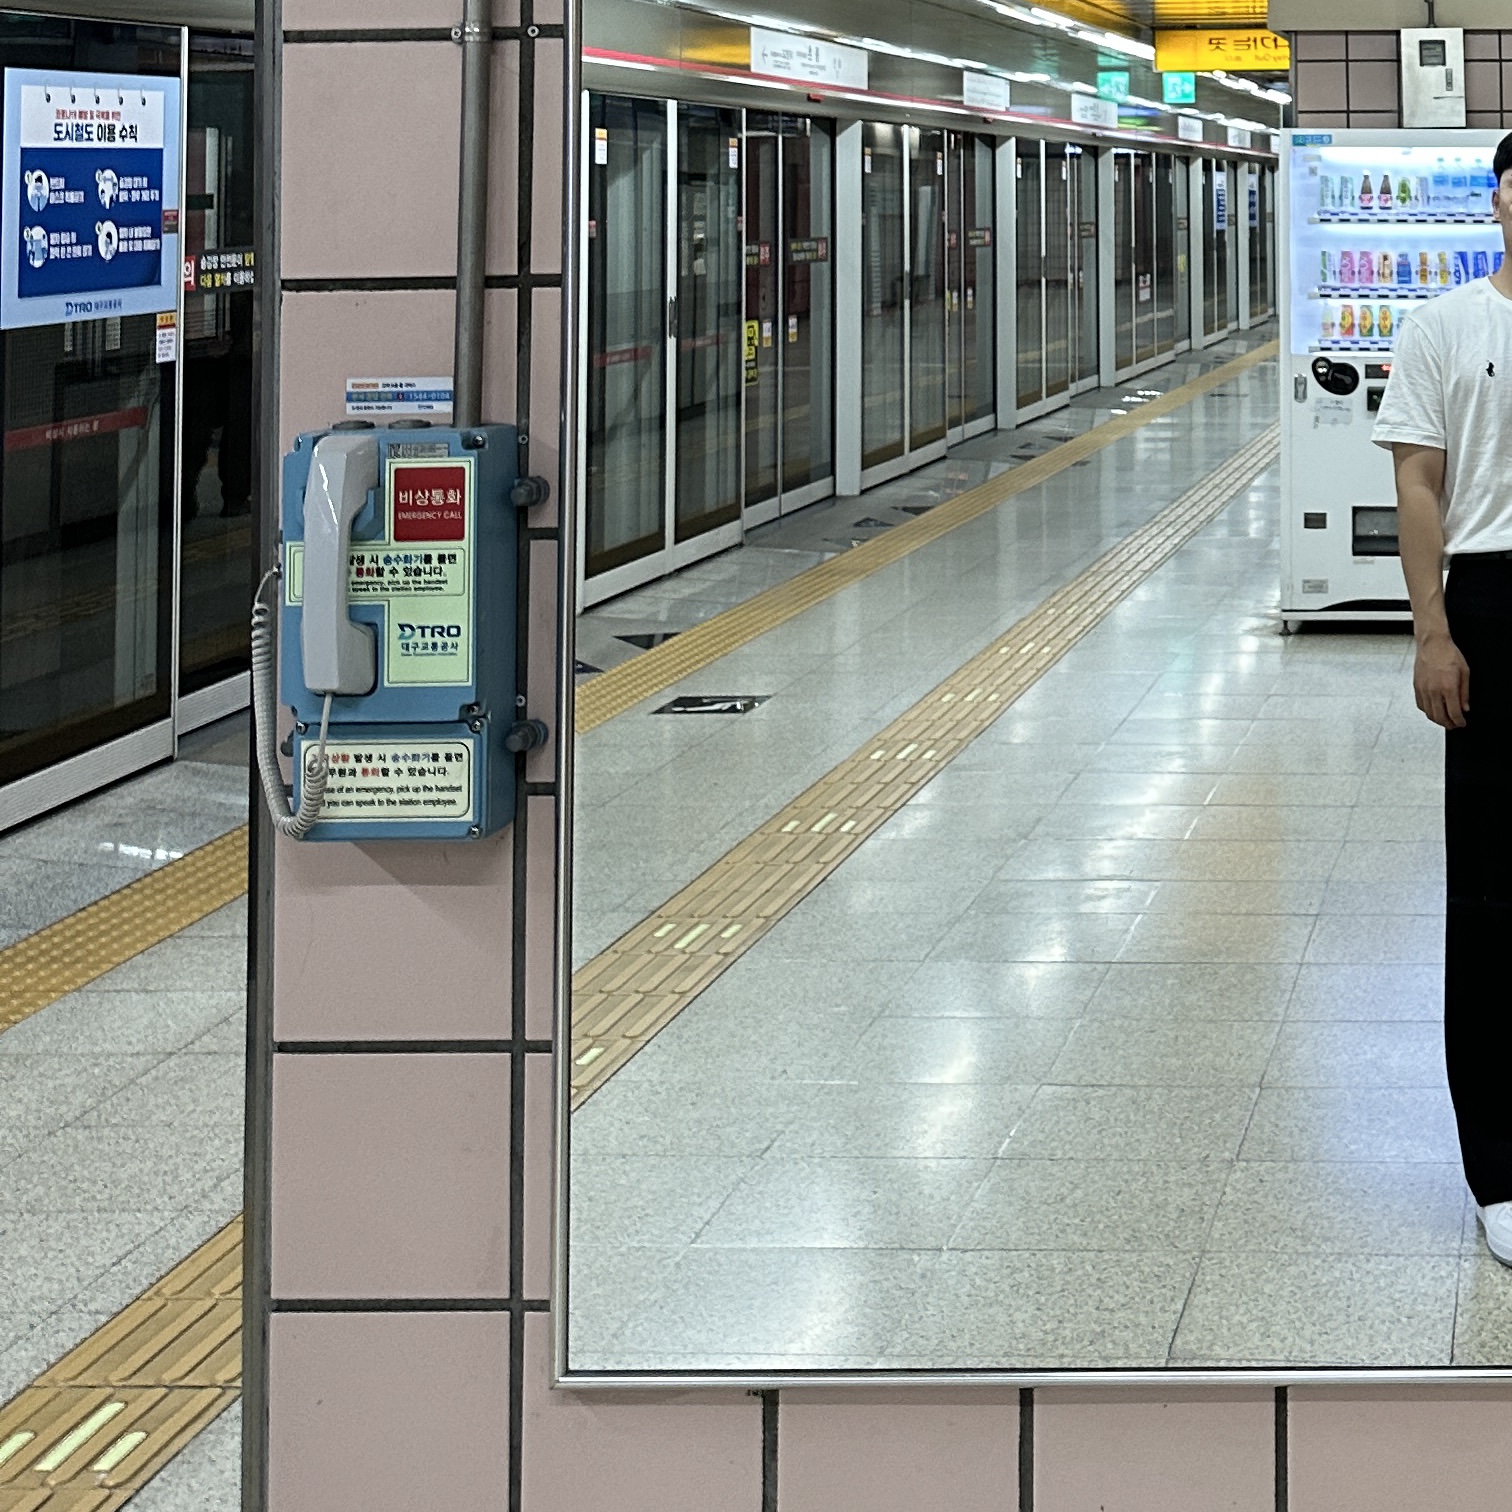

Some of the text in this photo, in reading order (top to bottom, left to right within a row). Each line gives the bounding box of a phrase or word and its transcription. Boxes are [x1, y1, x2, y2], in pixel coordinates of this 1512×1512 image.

[53, 122, 138, 144] 도시철도 이용 수칙
[398, 488, 462, 506] 비상통화
[398, 510, 463, 520] EMERGENCY CALL
[397, 622, 461, 640] DTRO
[401, 641, 459, 652] 대구교통공사
